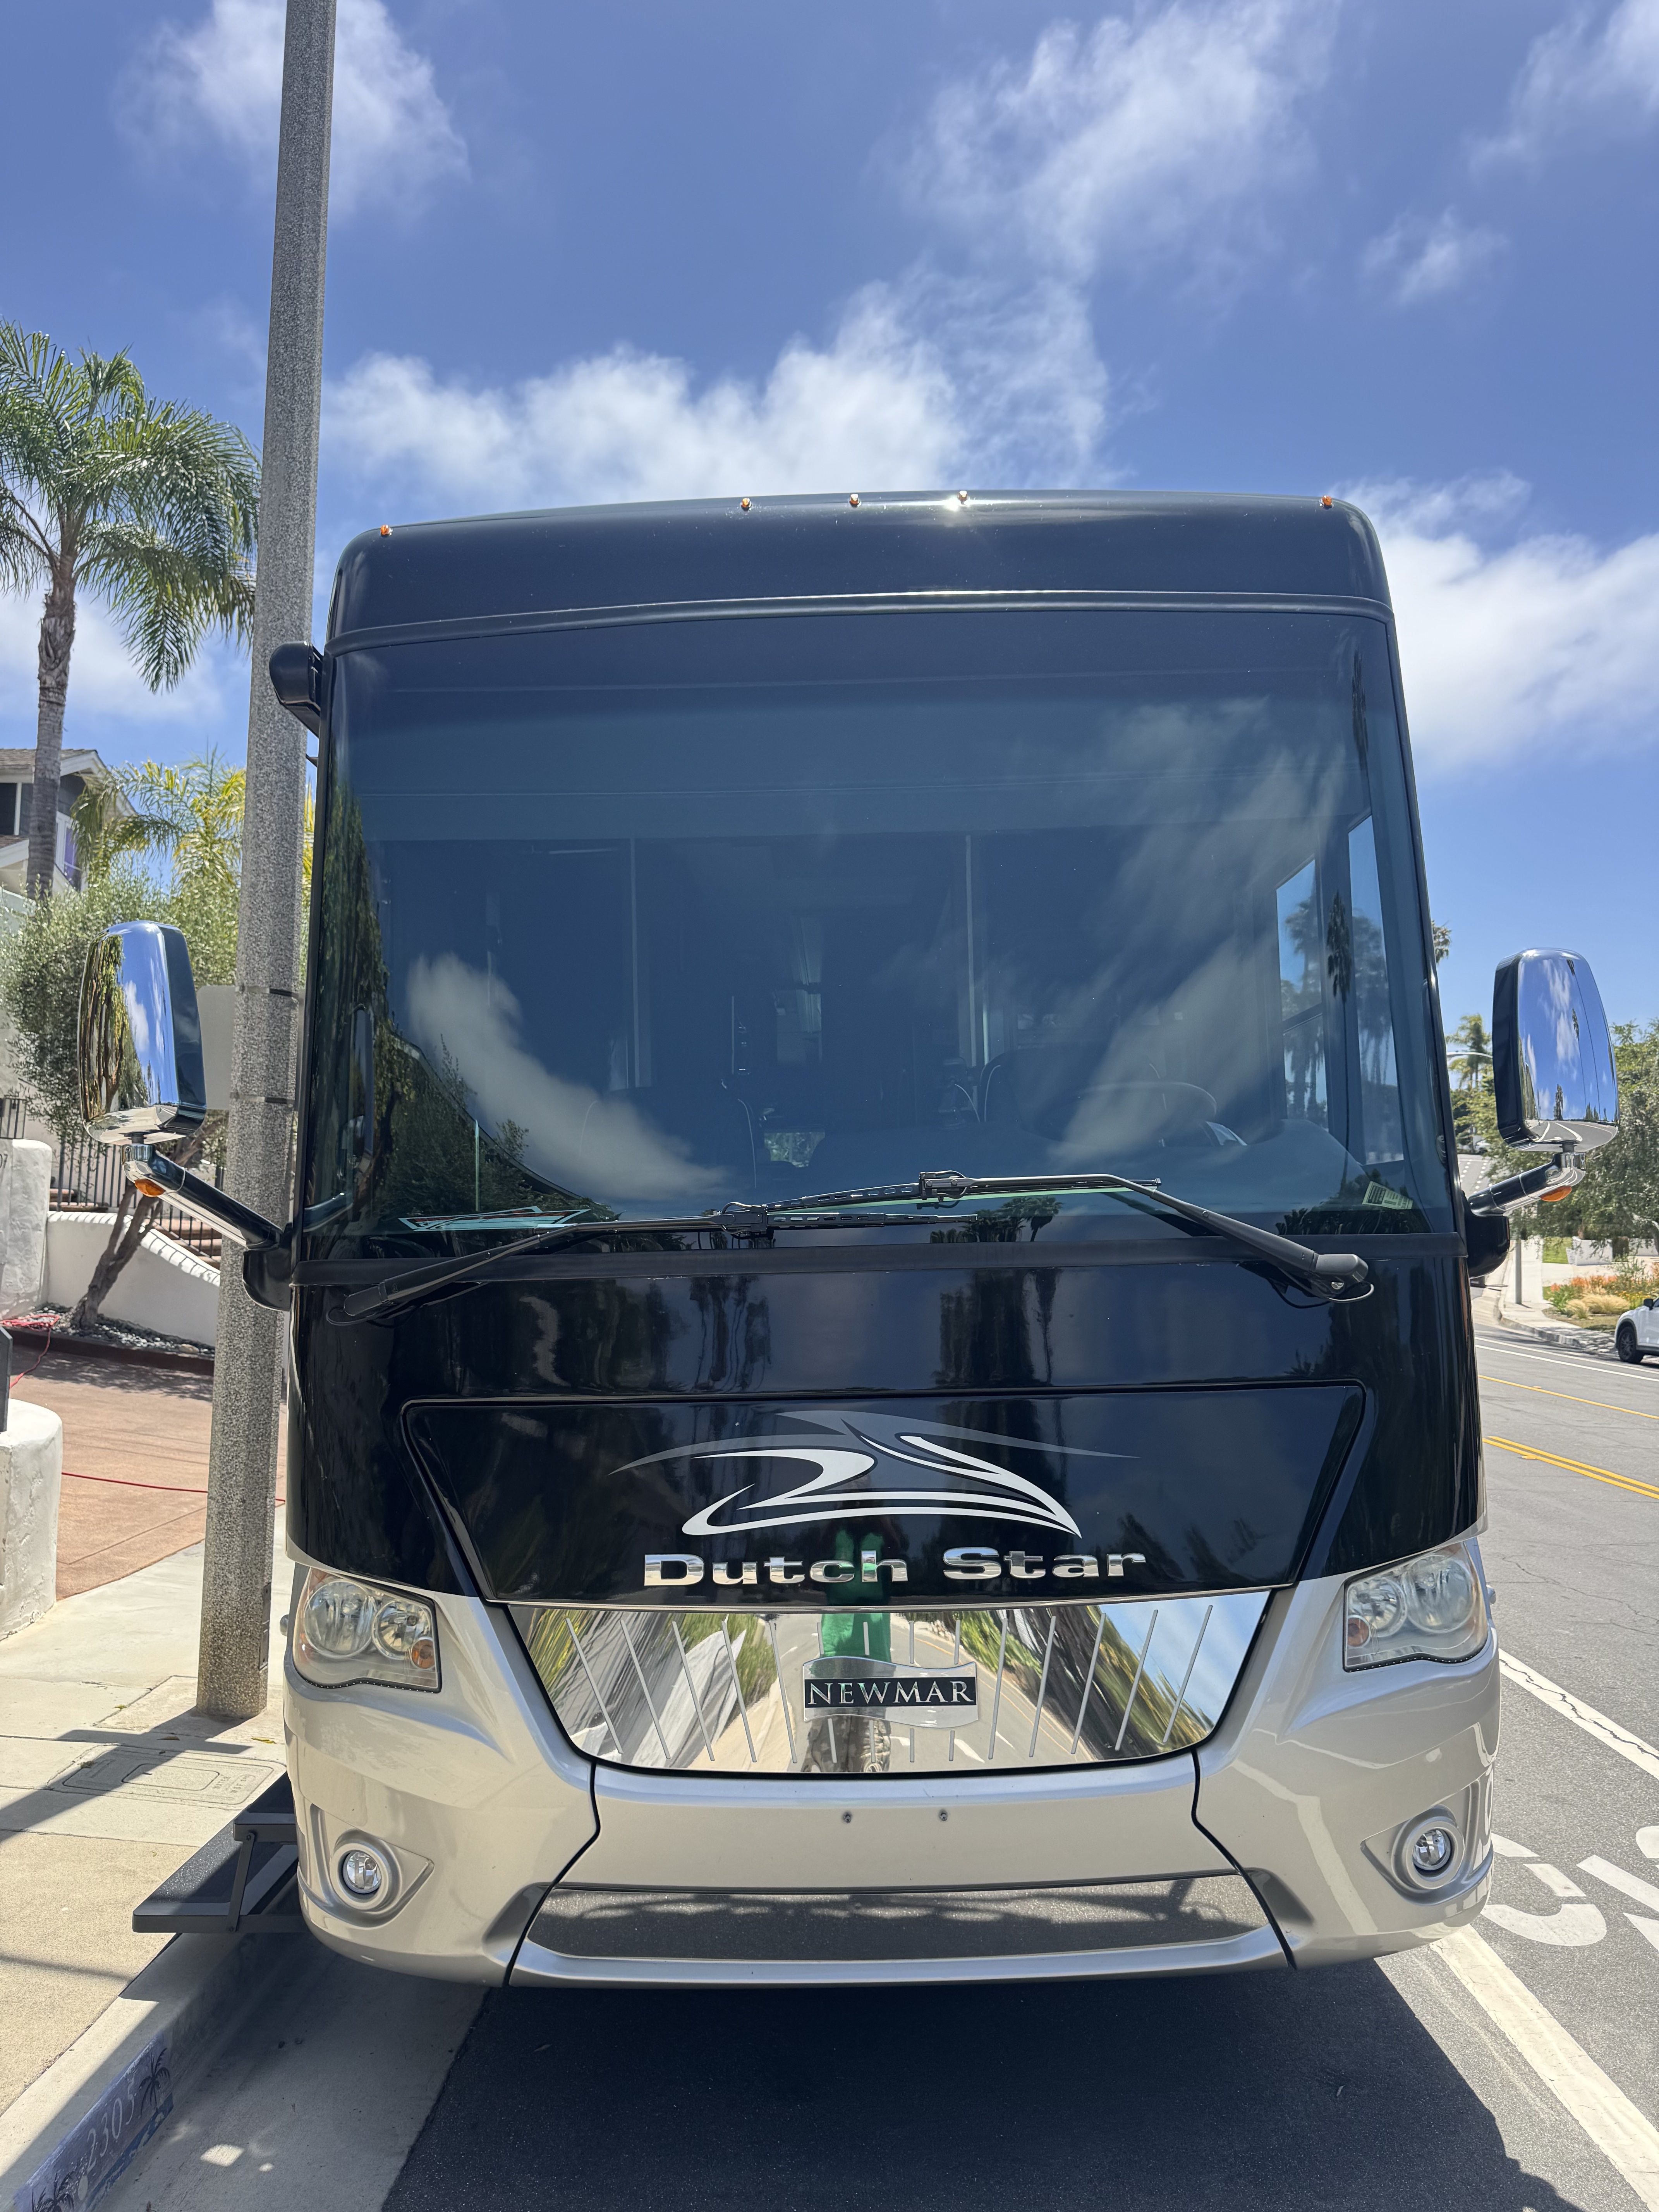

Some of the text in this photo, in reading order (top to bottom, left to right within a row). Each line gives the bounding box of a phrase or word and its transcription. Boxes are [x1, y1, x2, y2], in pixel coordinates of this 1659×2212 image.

[644, 1546, 1147, 1587] Dutch Star
[808, 1681, 974, 1705] NEWMAR
[212, 1776, 232, 1789] WATER
